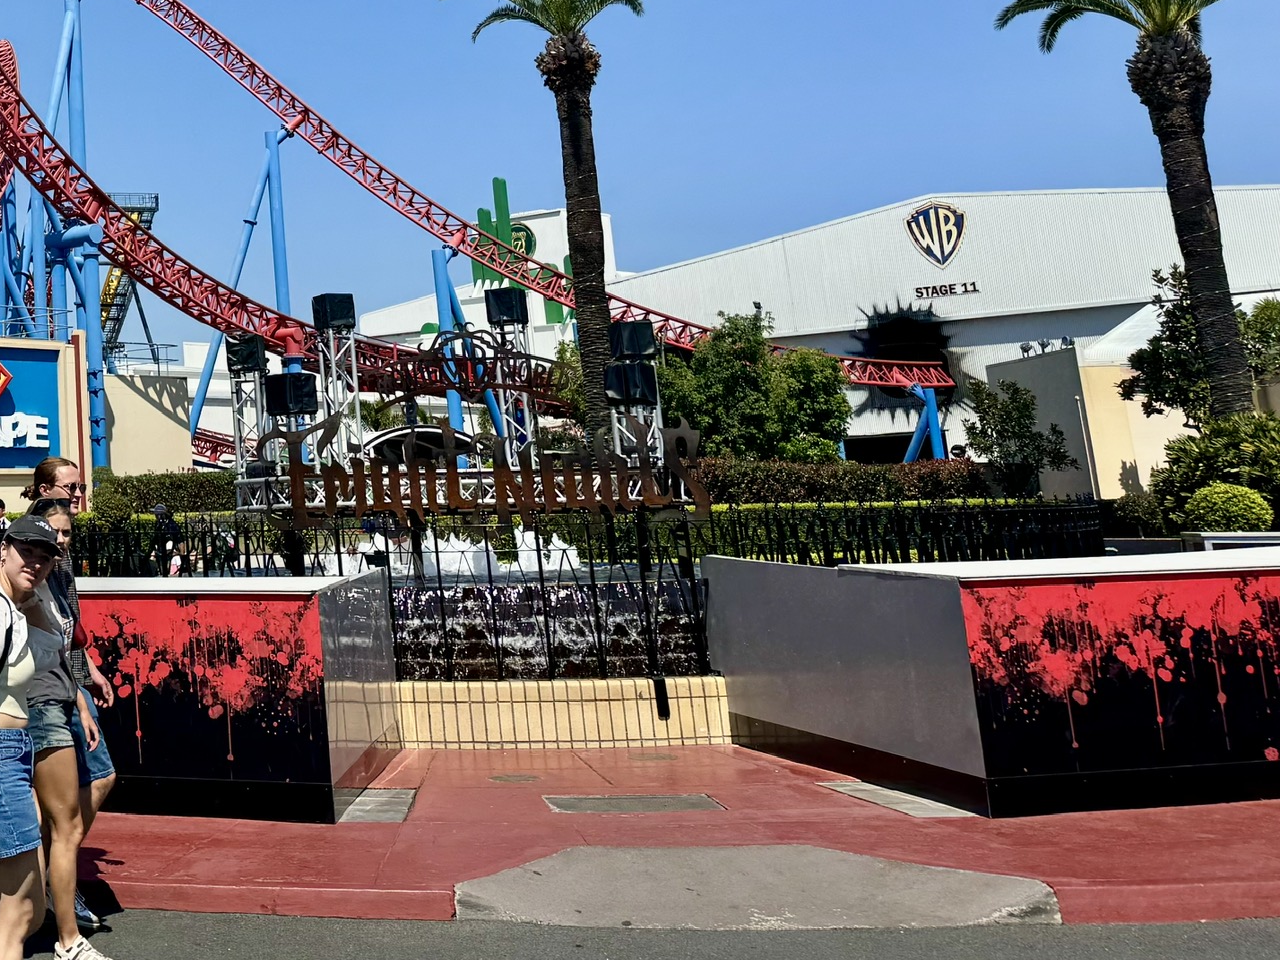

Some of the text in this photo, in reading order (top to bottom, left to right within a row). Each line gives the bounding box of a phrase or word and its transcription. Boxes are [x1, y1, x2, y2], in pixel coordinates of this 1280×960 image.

[910, 208, 958, 262] WB
[915, 282, 980, 298] STAGE 11
